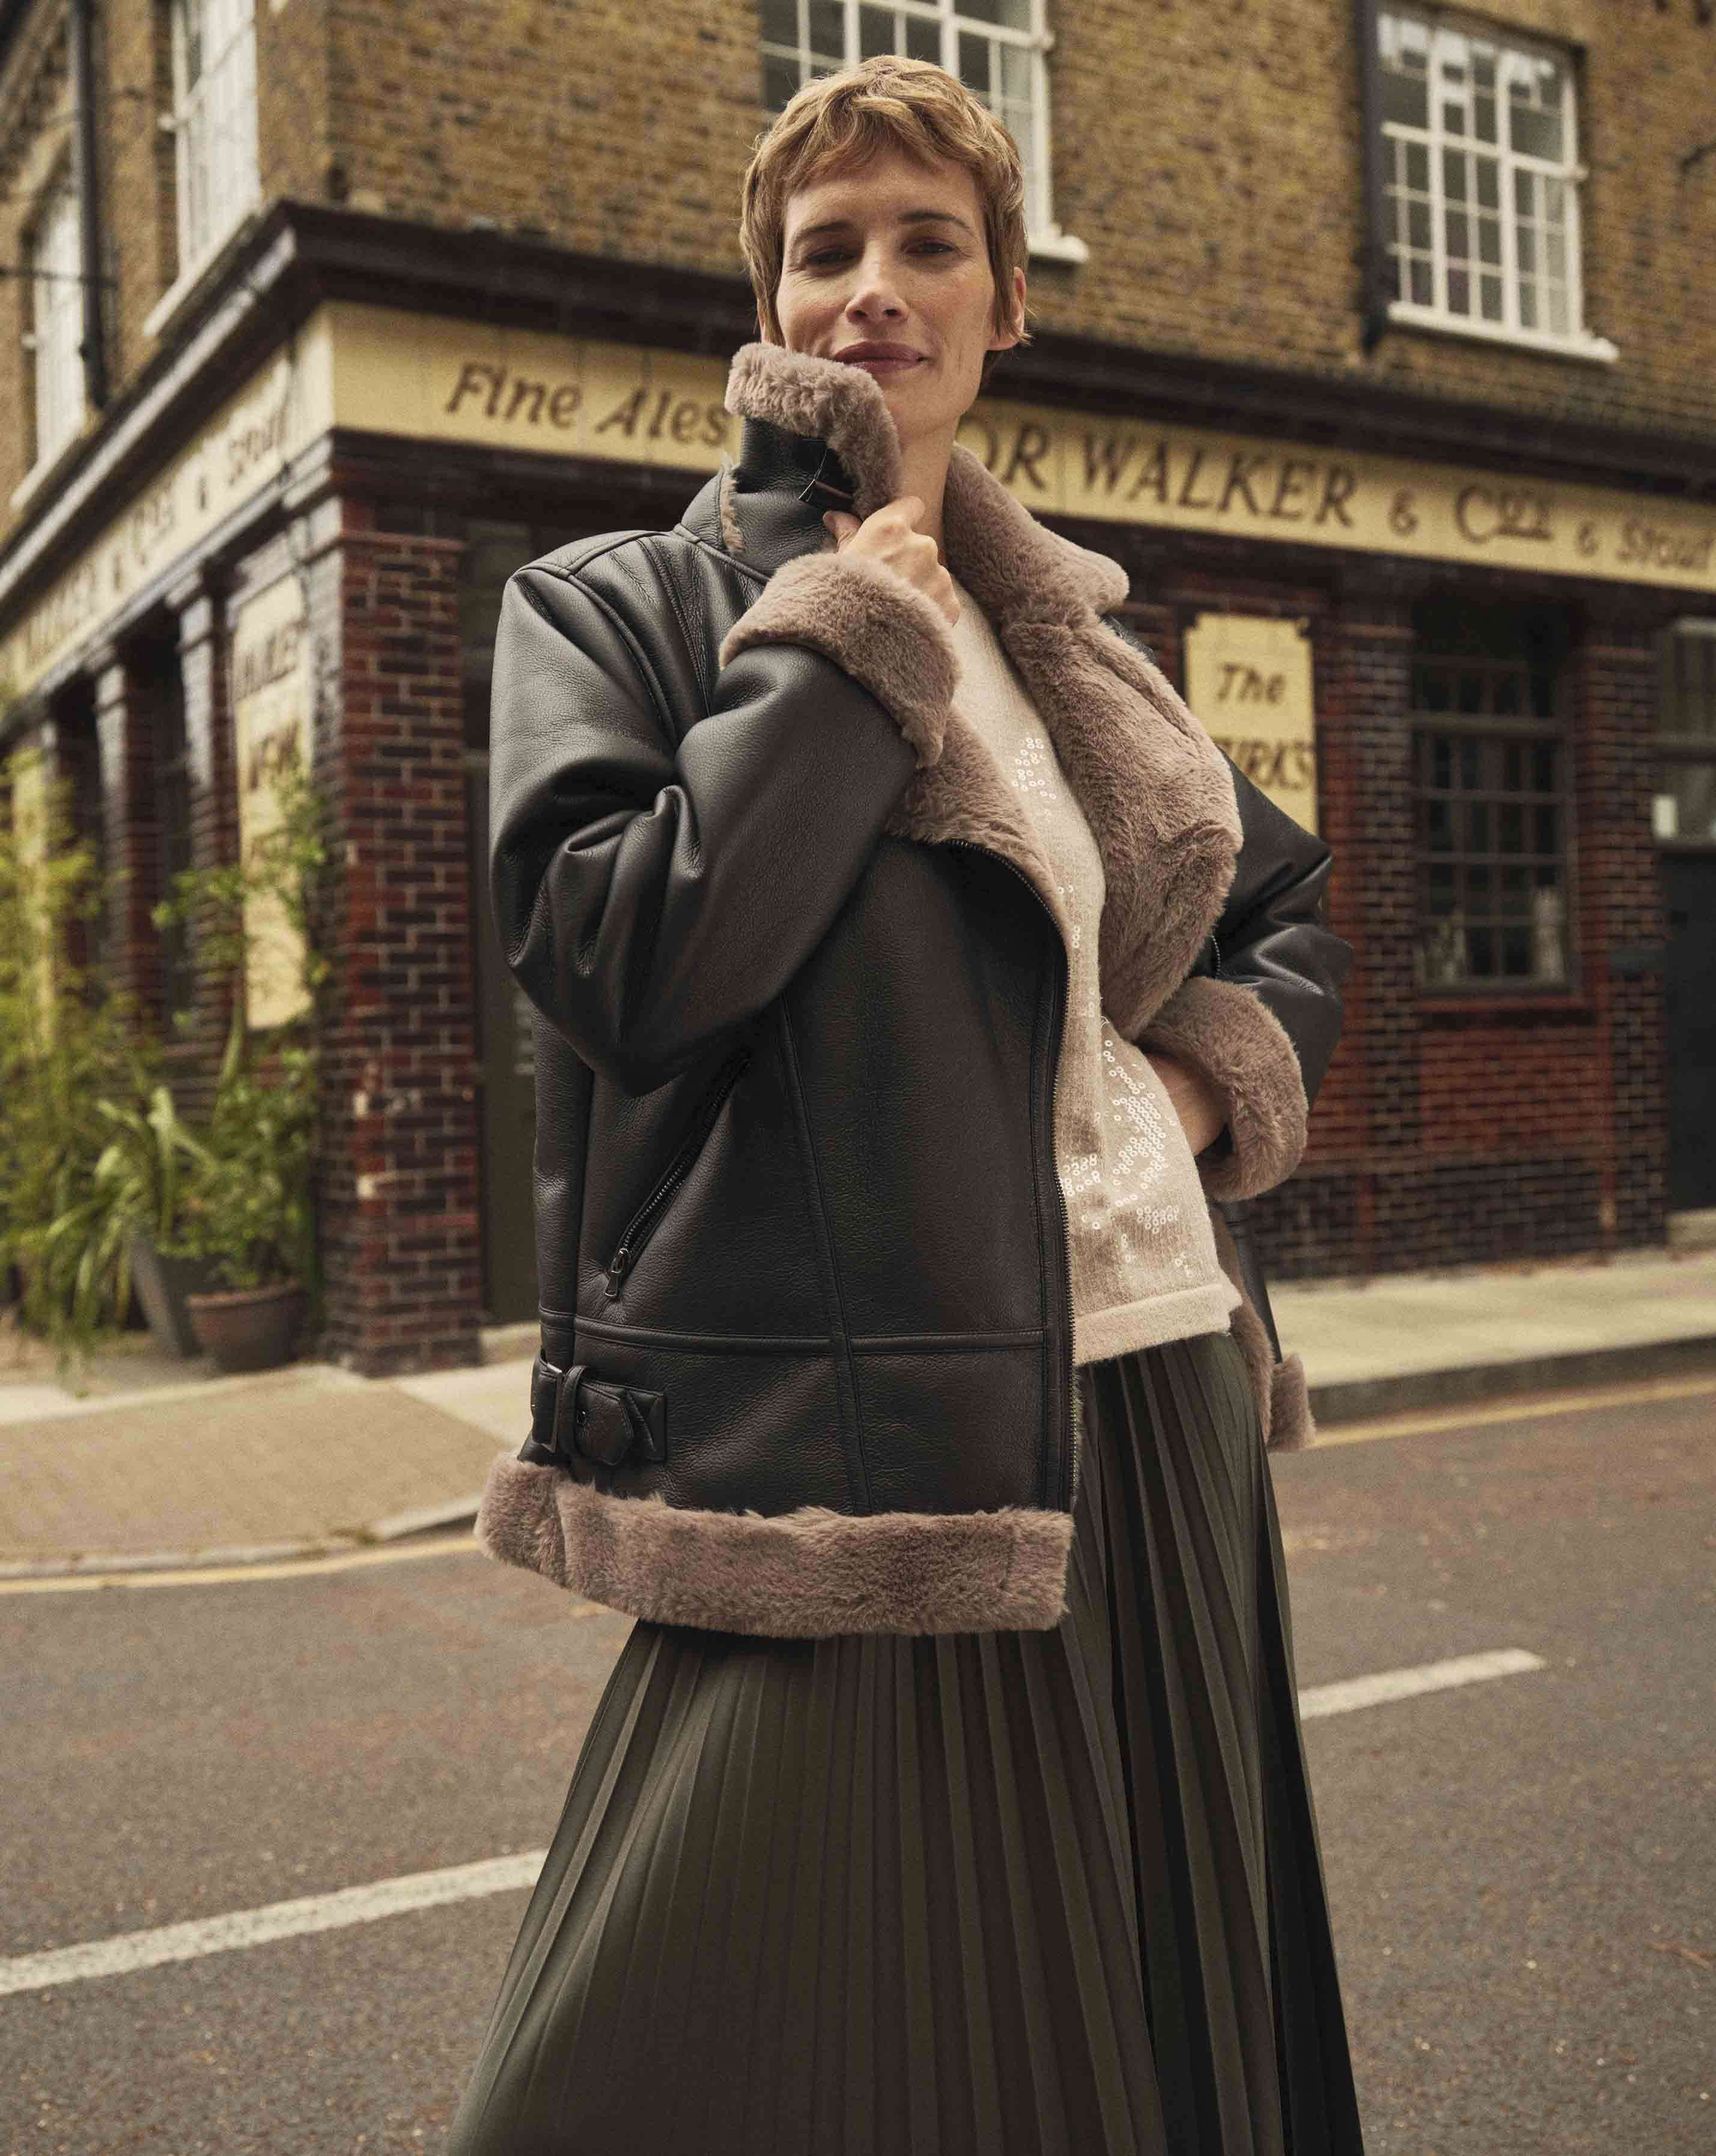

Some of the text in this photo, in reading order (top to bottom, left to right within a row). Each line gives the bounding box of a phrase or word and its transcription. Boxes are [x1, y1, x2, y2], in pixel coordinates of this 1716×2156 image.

[443, 360, 731, 449] Fine Ales
[1083, 428, 1358, 529] WALKER
[1215, 661, 1288, 706] The
